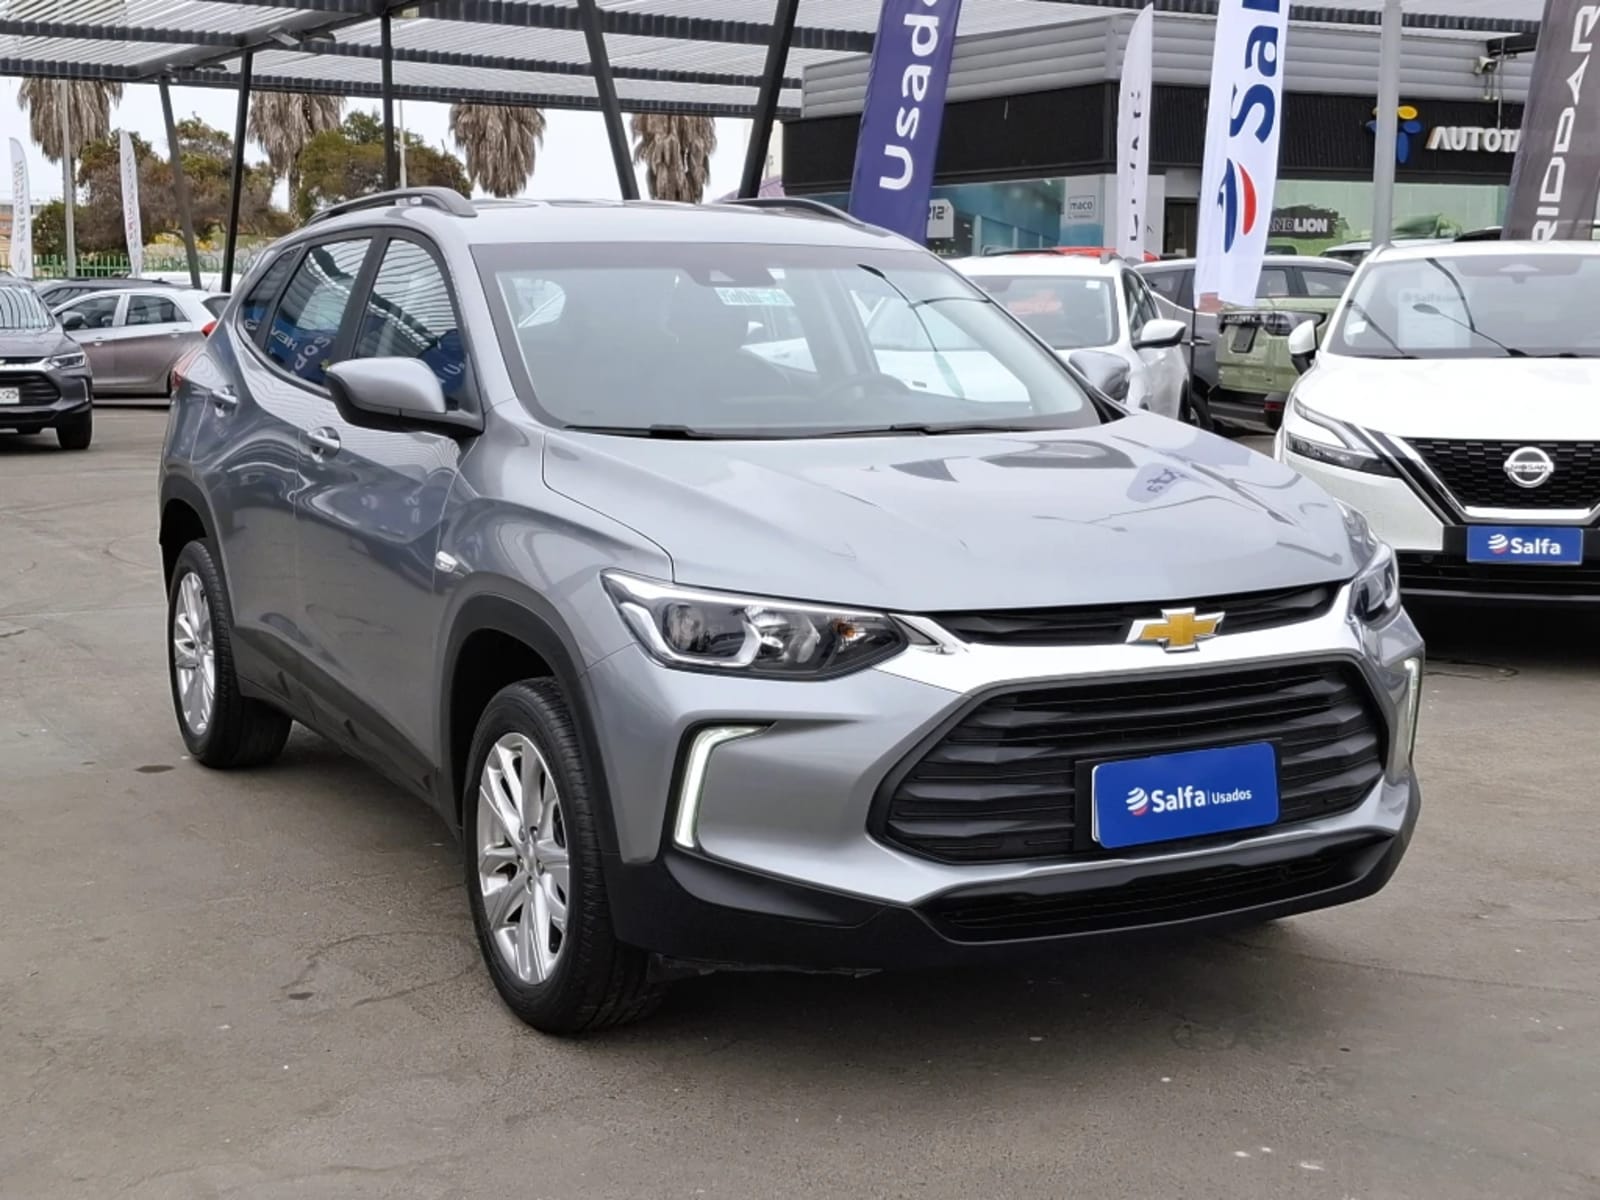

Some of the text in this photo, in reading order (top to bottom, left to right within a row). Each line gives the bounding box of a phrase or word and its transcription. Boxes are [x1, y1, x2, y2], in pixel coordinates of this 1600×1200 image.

[879, 0, 940, 190] Usad
[928, 205, 945, 220] 12
[1510, 537, 1562, 555] Salfa
[1151, 785, 1252, 813] Salfa Usados
